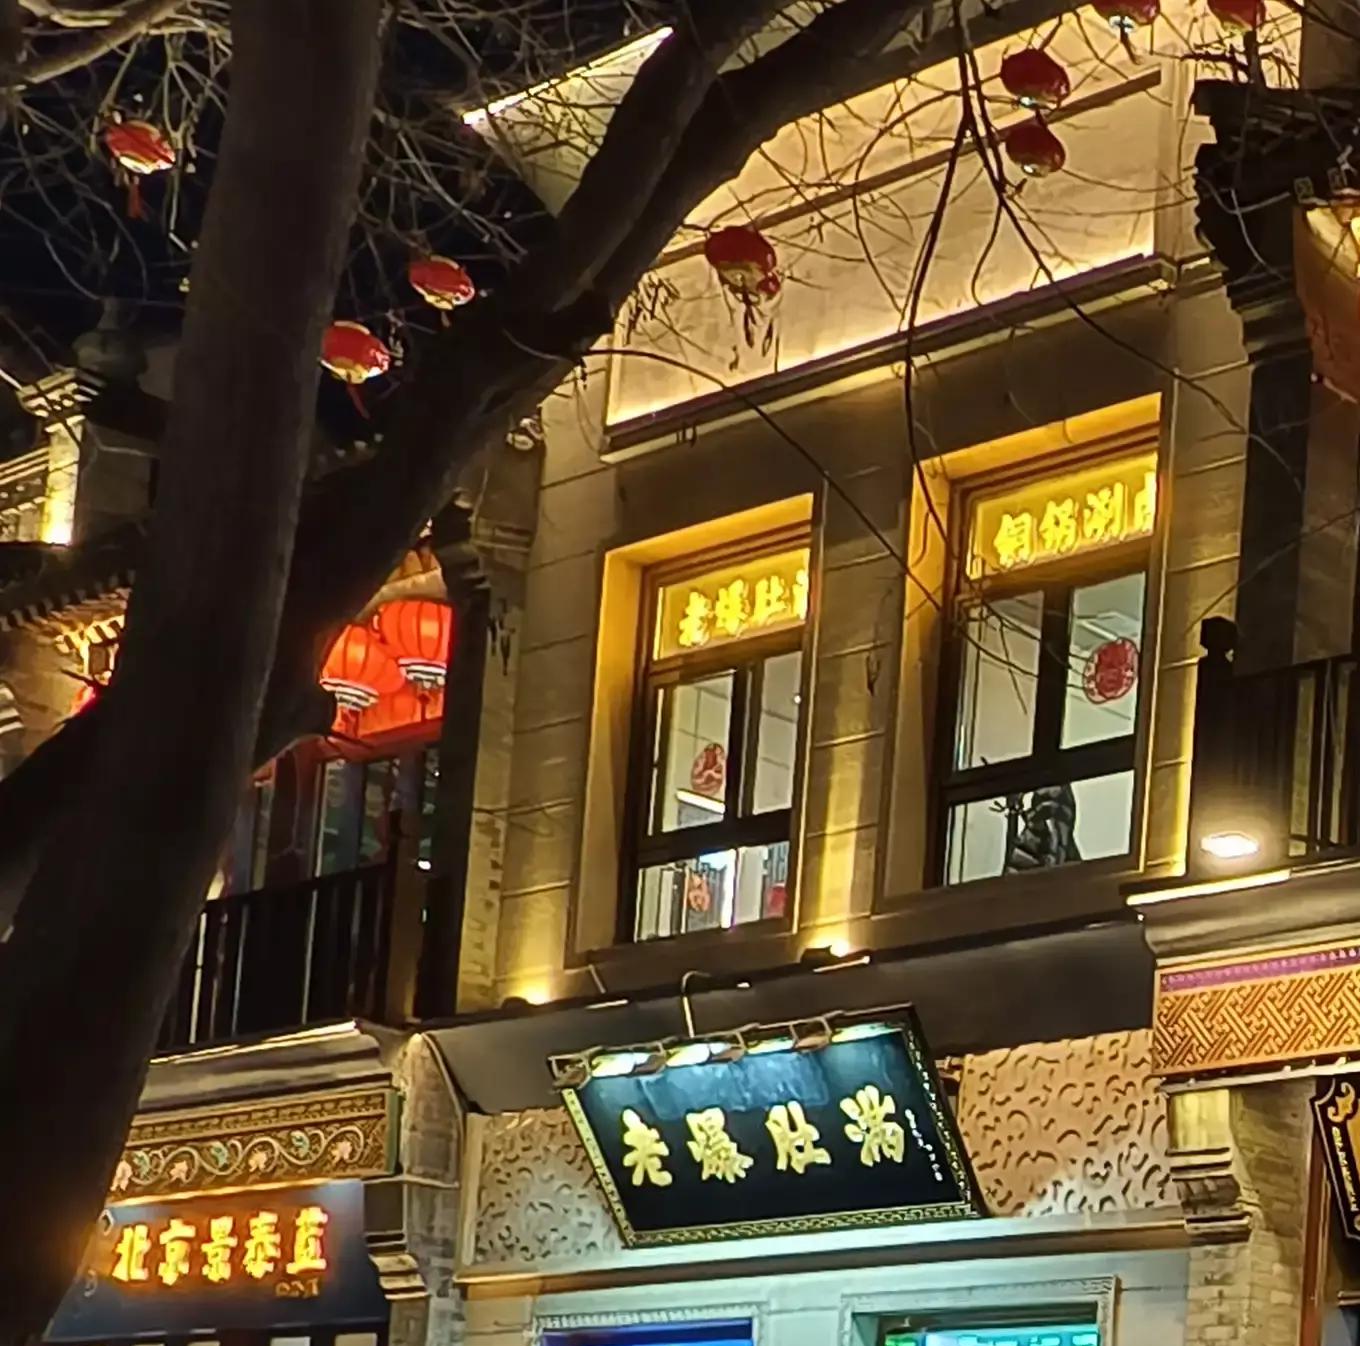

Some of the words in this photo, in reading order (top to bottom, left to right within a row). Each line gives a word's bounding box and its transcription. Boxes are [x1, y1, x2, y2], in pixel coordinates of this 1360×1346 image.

[112, 1207, 329, 1286] 北京景泰蓝
